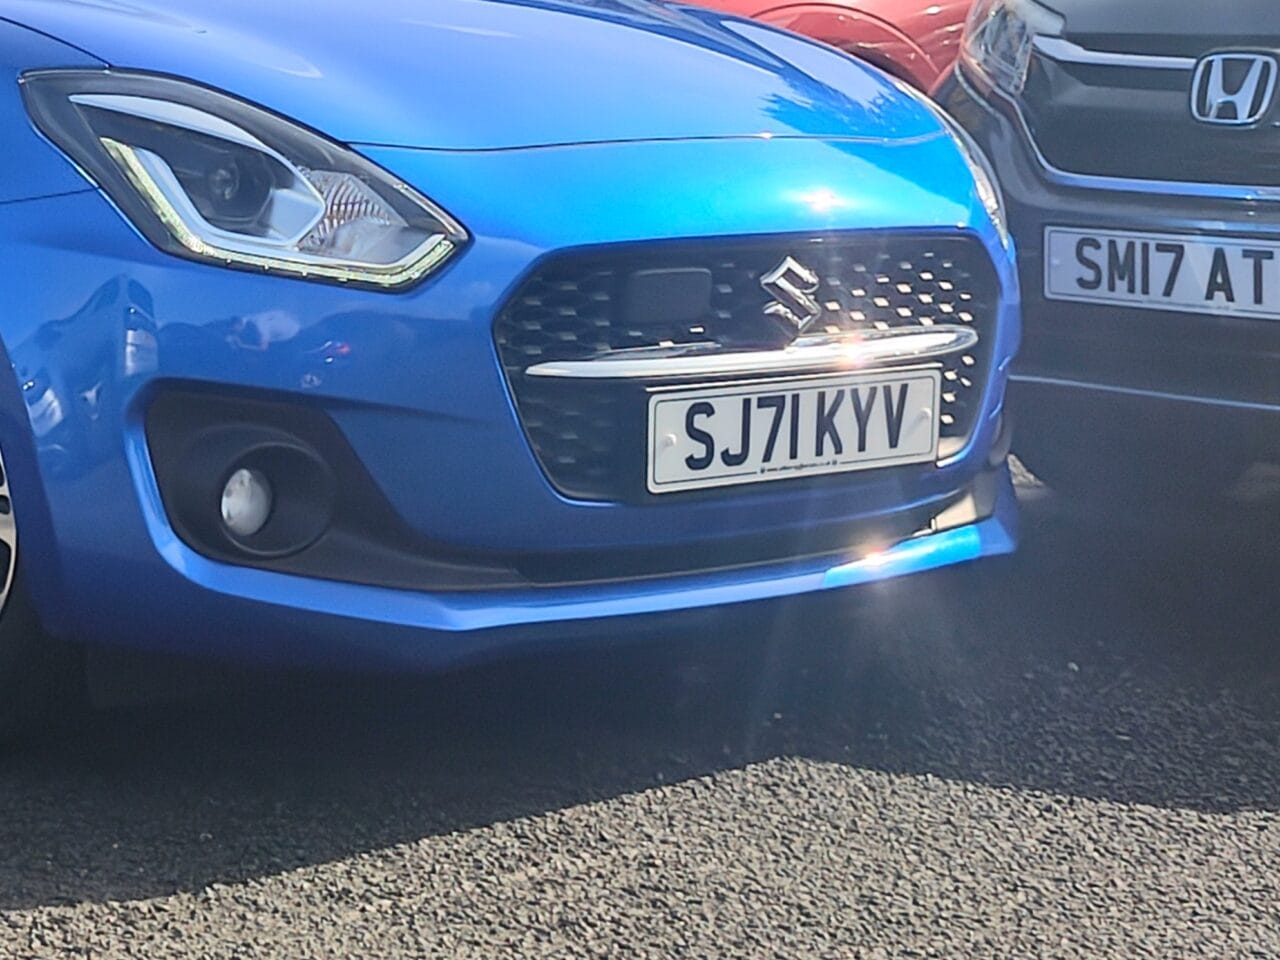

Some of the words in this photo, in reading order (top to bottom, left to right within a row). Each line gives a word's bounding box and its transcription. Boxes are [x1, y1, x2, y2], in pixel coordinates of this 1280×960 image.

[1076, 237, 1185, 298] SM17
[1205, 246, 1275, 305] AT
[685, 392, 801, 471] SJ71
[815, 382, 909, 458] KYV
